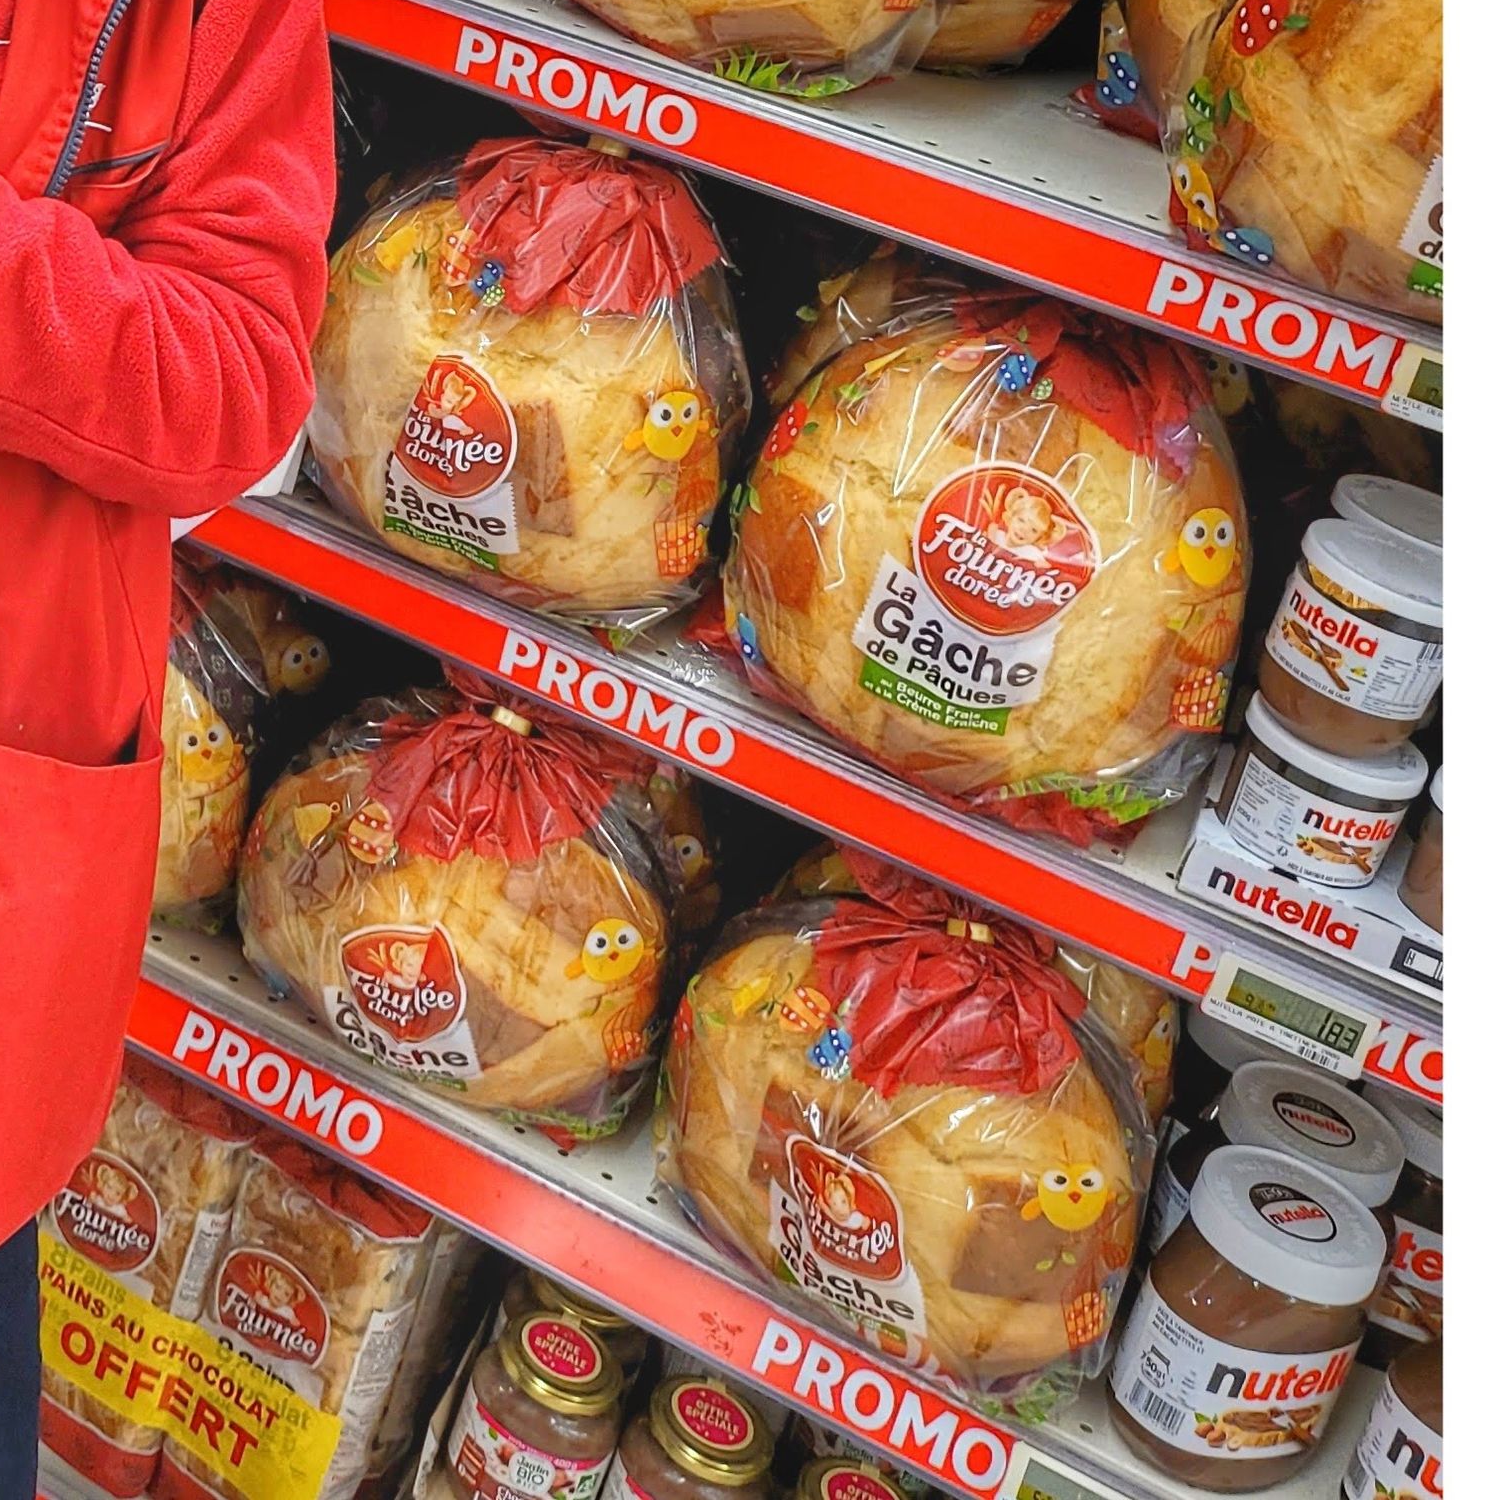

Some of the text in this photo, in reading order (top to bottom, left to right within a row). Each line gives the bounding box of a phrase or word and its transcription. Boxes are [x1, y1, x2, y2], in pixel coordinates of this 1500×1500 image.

[453, 25, 700, 148] PROMO
[1144, 261, 1399, 391] PROM
[406, 509, 490, 548] Pâques
[922, 513, 1078, 608] Fournée
[886, 571, 919, 606] La
[944, 566, 1012, 609] dorée
[873, 598, 1039, 688] Gâche
[1288, 589, 1379, 660] nutella
[498, 627, 738, 768] PROMO
[866, 638, 1008, 706] de Pâques
[896, 681, 942, 712] Beurre
[896, 693, 942, 721] Crème
[1301, 807, 1396, 843] nutella
[1206, 865, 1359, 951] nutella
[171, 1010, 386, 1158] PROMO
[1280, 1105, 1353, 1139] nutella
[55, 1188, 151, 1252] Fournée
[73, 1221, 117, 1251] dorée
[1269, 1198, 1327, 1225] nutella
[40, 1264, 282, 1429] PAINS AU CHOCOLAT
[220, 1282, 319, 1356] Fournée
[545, 1330, 582, 1355] OFFRE
[59, 1320, 260, 1469] OFFERT
[695, 1399, 732, 1421] OFFRE
[751, 1317, 1008, 1492] PROMO
[516, 1455, 550, 1477] Jardin
[516, 1466, 545, 1486] BIO
